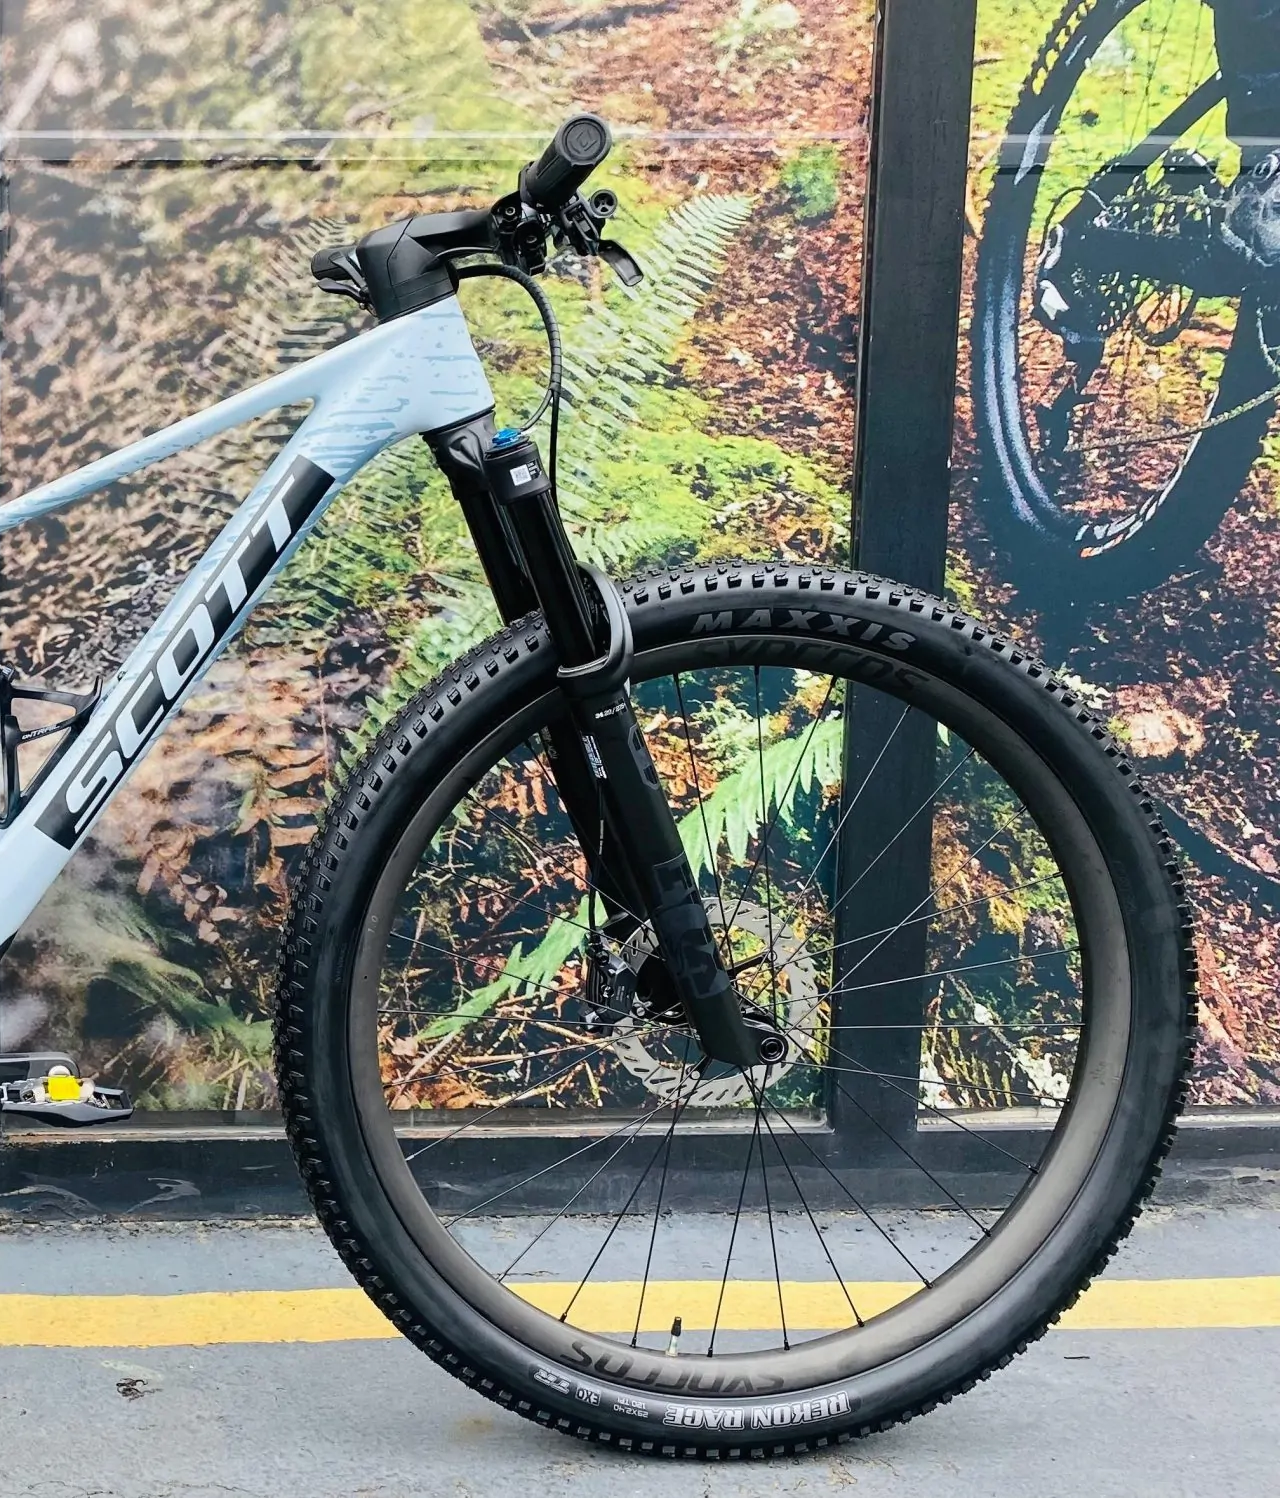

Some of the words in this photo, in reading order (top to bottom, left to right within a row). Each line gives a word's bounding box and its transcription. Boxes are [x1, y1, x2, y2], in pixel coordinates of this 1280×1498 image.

[690, 609, 917, 650] MAXXIS
[65, 474, 295, 833] SCOTT
[533, 1367, 571, 1395] TR
[575, 1386, 602, 1407] EXO
[617, 1397, 630, 1407] TPI
[631, 1401, 646, 1410] 120
[750, 1391, 852, 1429] REKON
[663, 1401, 745, 1430] RACE
